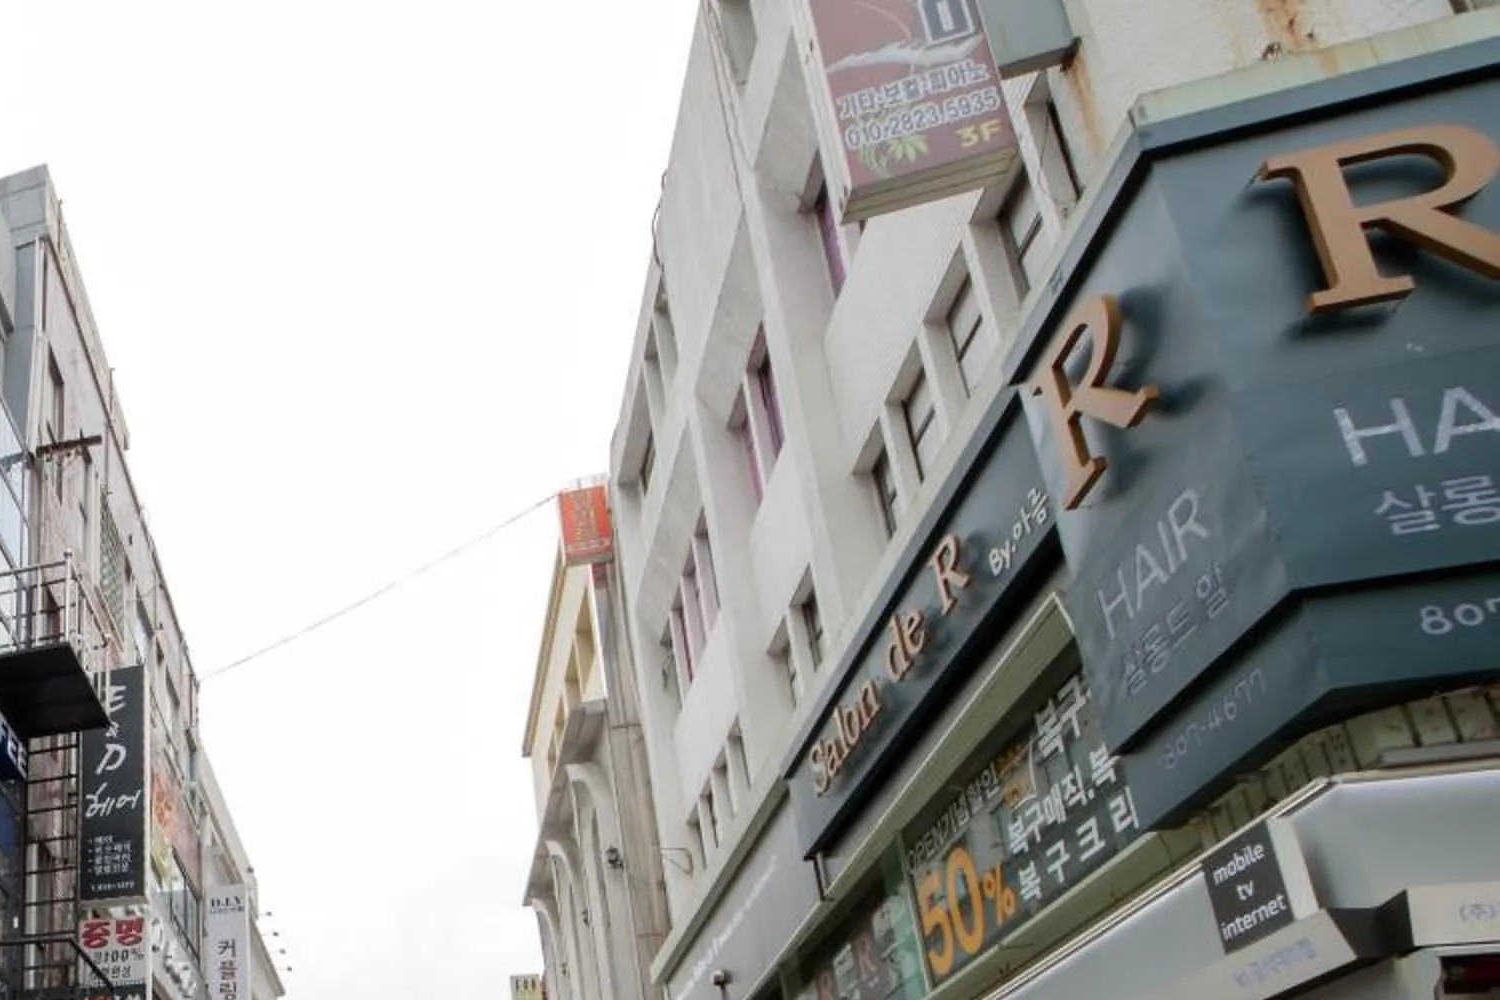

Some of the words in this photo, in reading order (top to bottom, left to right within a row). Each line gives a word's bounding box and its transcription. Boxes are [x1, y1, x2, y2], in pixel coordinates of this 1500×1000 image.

[956, 119, 1001, 147] 3F
[1258, 123, 1500, 315] R
[1008, 294, 1160, 511] R
[1095, 489, 1211, 639] HAIR
[808, 680, 889, 797] Salon
[883, 607, 926, 683] de
[929, 533, 971, 617] R
[85, 782, 142, 818] 헤어
[1212, 843, 1265, 886] mobile
[1236, 878, 1255, 900] tv
[917, 846, 1018, 977] 50%
[1220, 893, 1288, 941] internet
